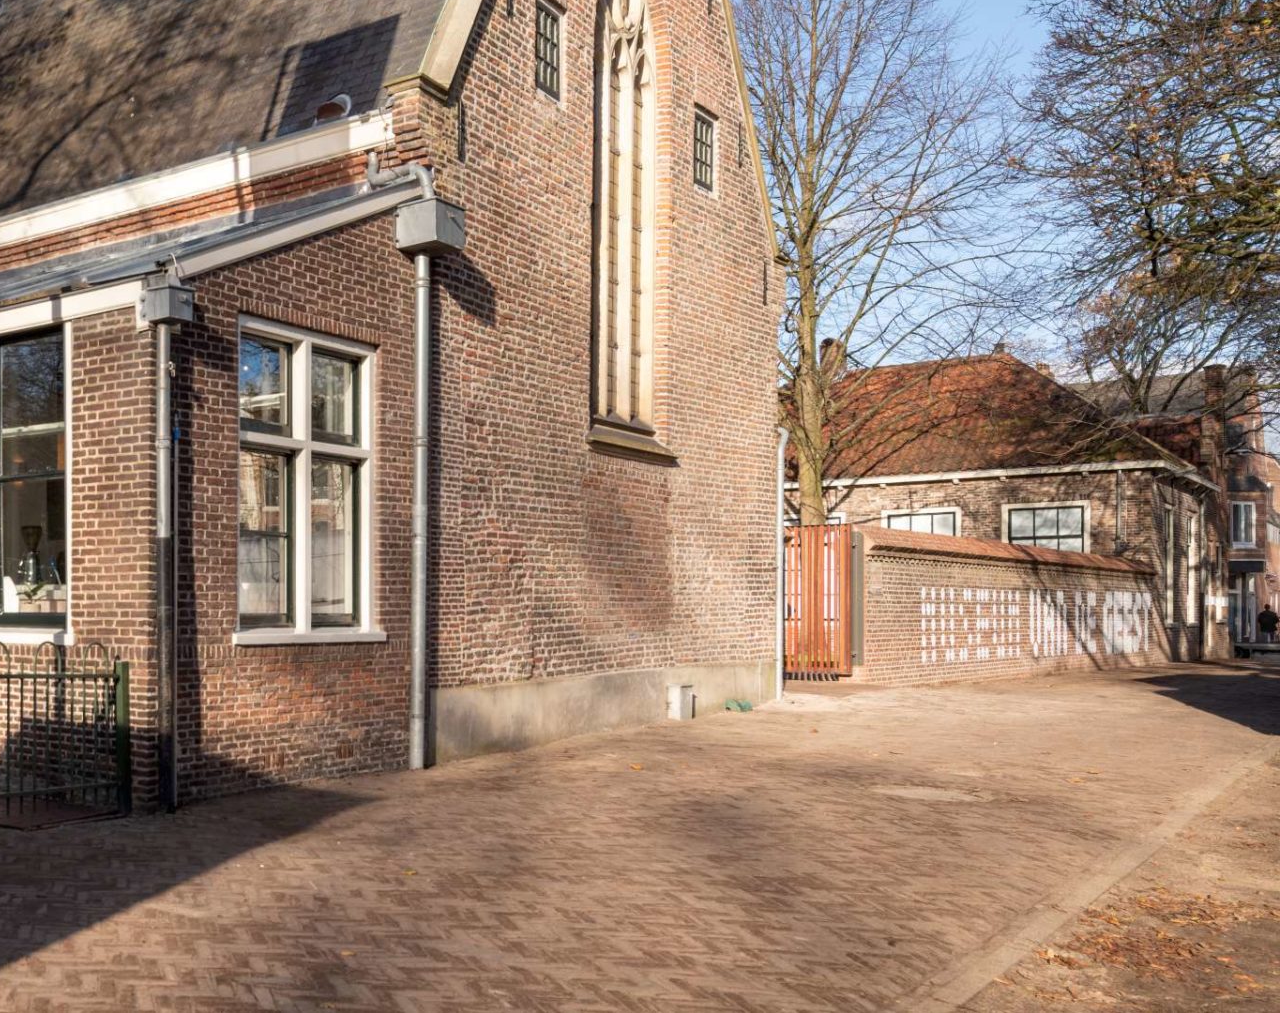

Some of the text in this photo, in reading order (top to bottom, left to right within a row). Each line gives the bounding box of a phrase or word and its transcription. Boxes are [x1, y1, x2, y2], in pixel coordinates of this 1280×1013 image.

[921, 587, 1151, 663] MUSEUM VAN DE GEEST
